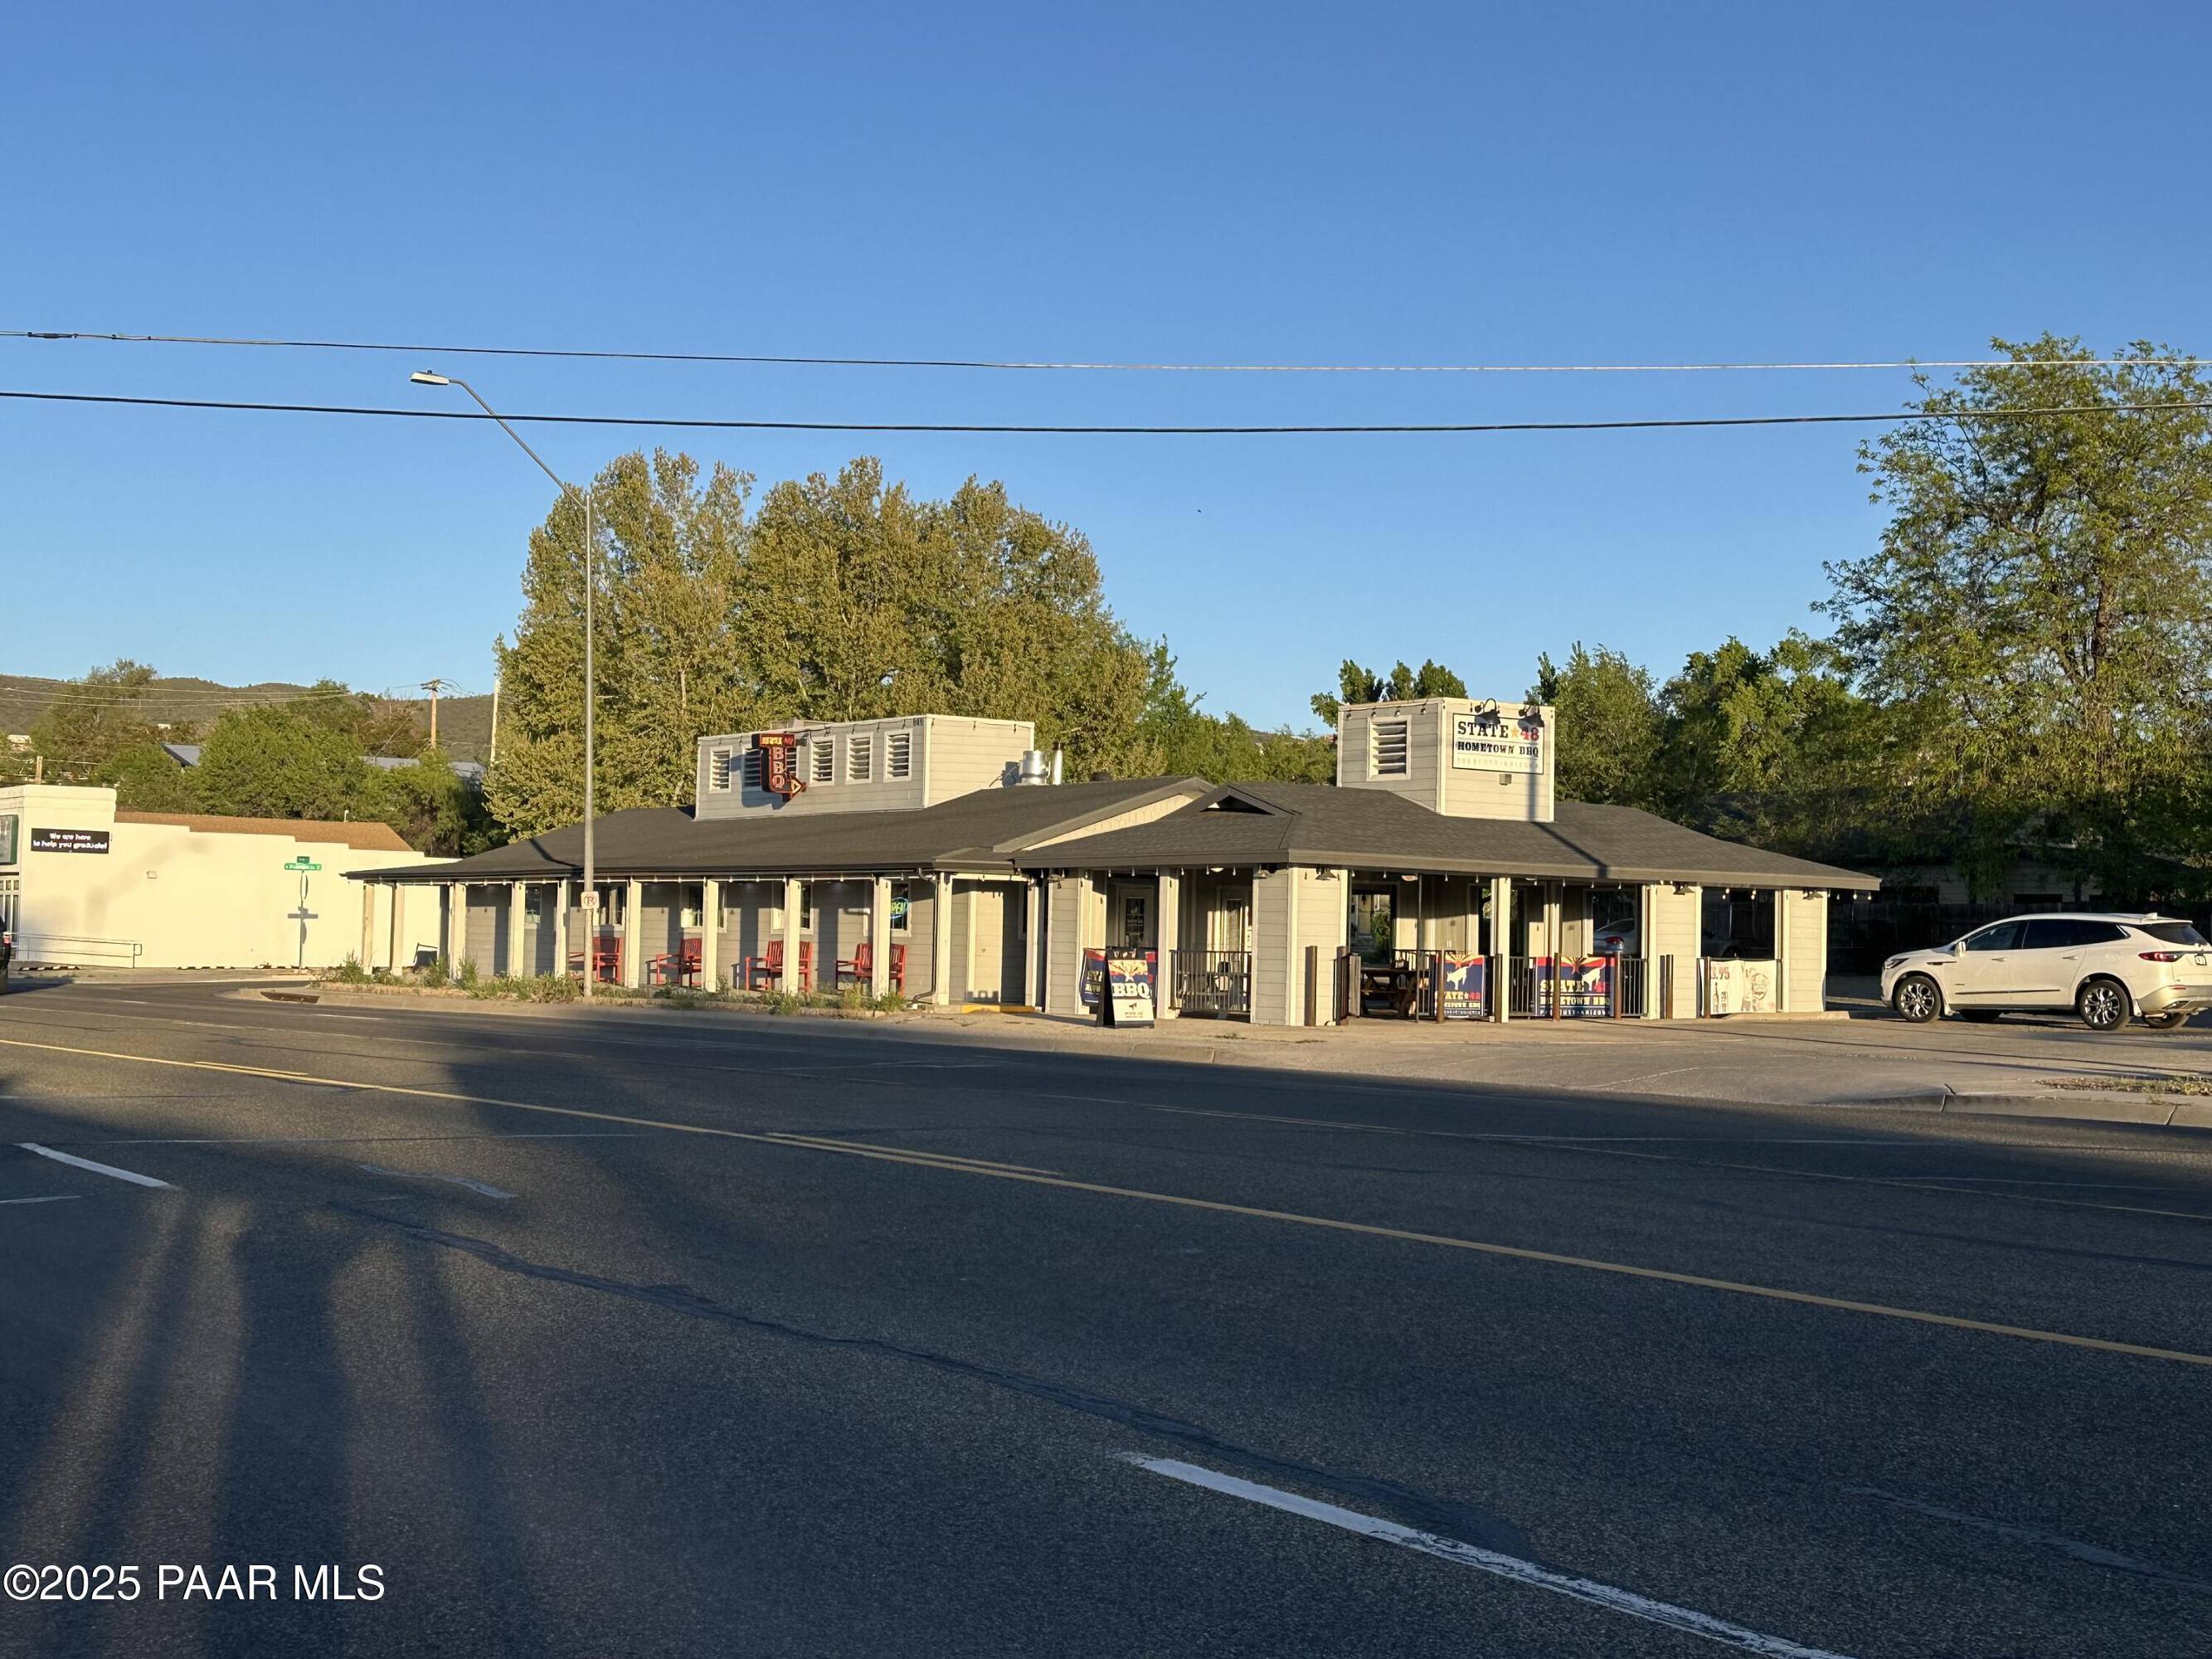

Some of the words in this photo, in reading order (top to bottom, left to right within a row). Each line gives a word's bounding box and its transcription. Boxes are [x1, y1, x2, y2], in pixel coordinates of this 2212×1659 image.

[1458, 721, 1509, 738] STATE
[1520, 727, 1539, 741] 48
[1457, 741, 1514, 755] HOMETOWN
[41, 840, 58, 849] help
[1112, 982, 1151, 1000] BBQ
